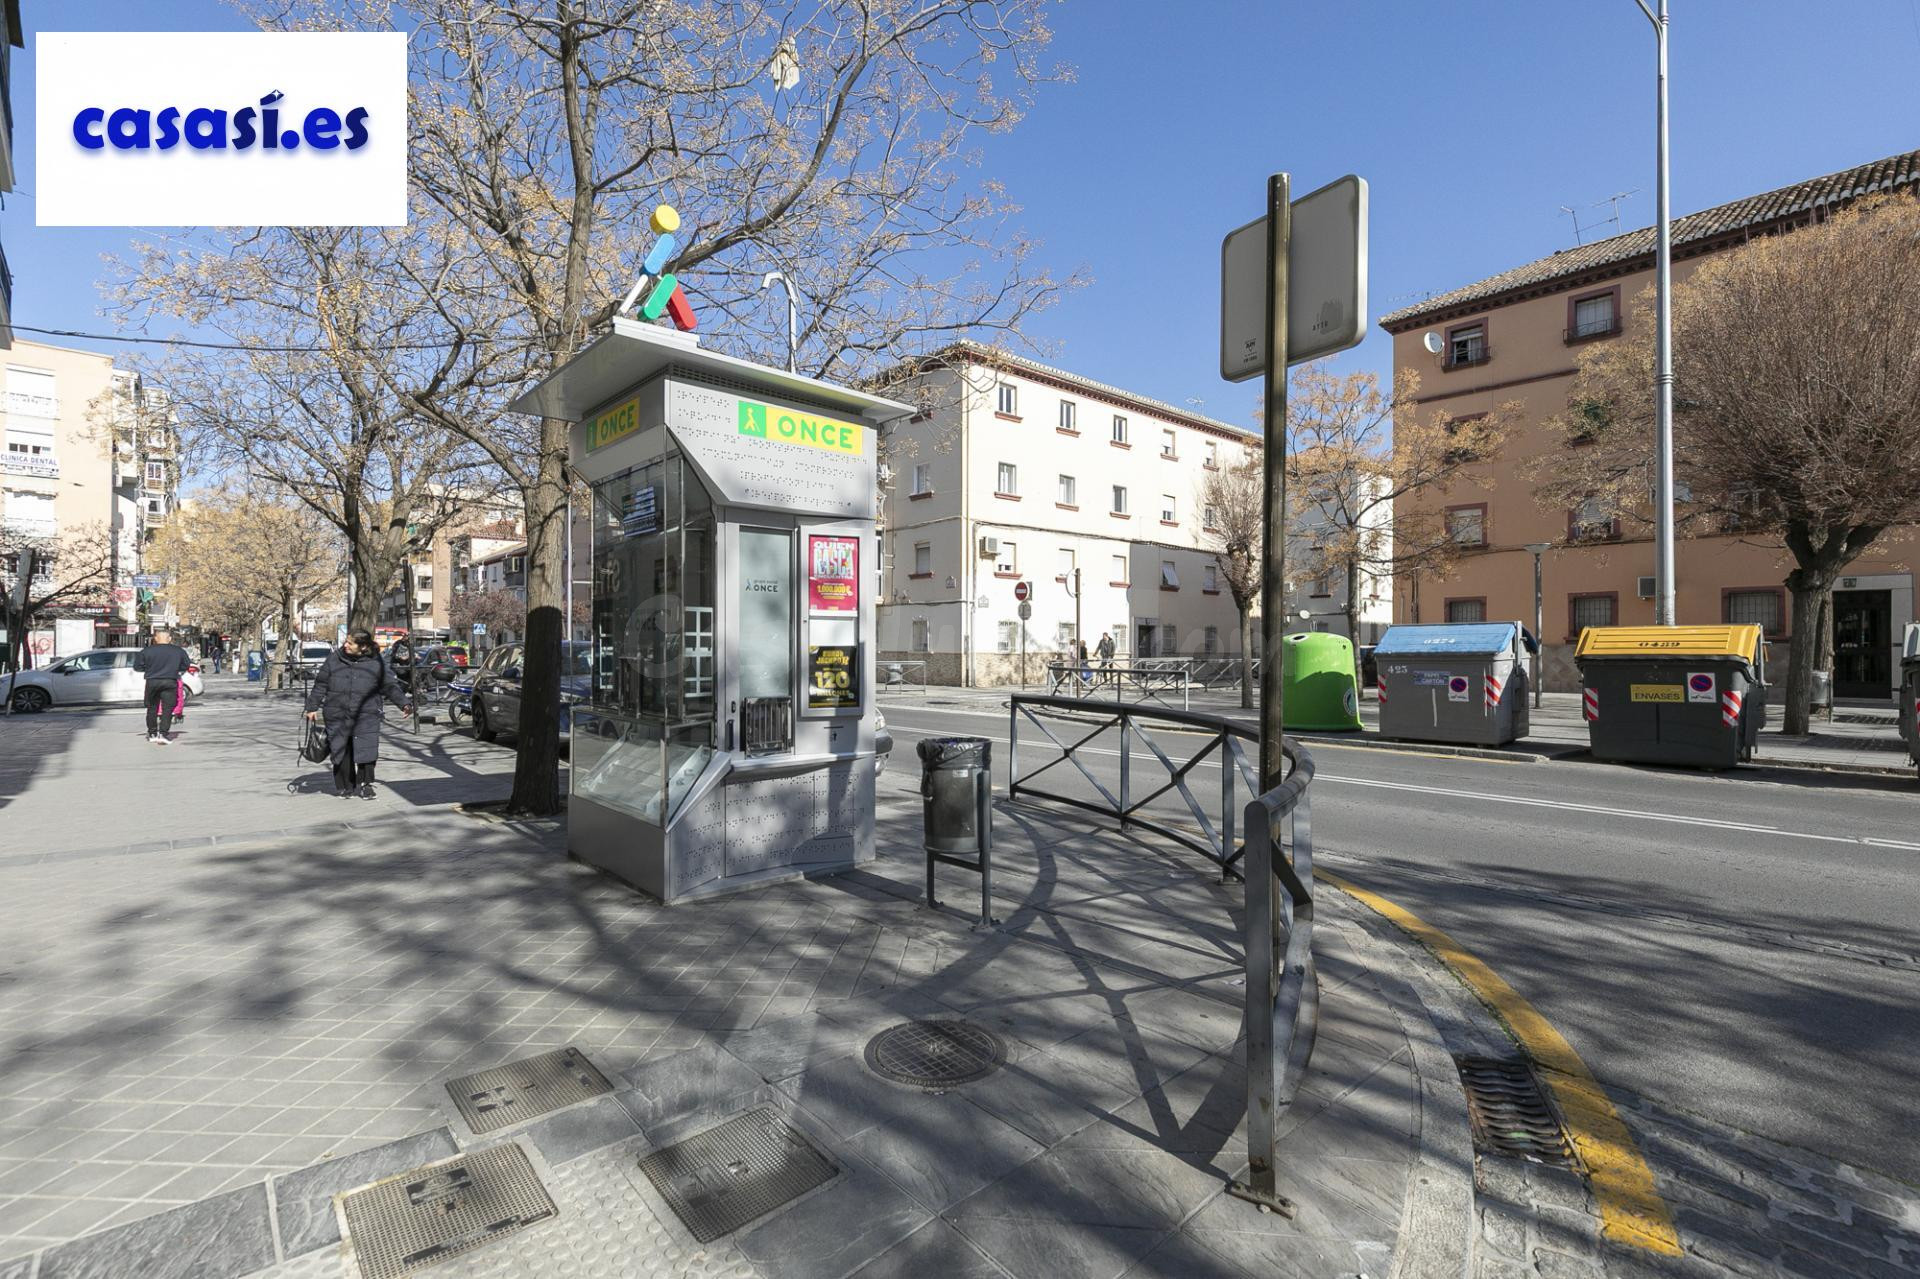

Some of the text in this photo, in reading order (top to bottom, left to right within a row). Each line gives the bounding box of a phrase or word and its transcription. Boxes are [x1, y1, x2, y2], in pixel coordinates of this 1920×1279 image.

[601, 404, 635, 440] ONCE
[777, 415, 853, 449] ONCE
[814, 541, 855, 550] QUIEN
[754, 584, 778, 592] ONCE
[815, 671, 849, 689] 120
[1634, 692, 1681, 700] ENVASES
